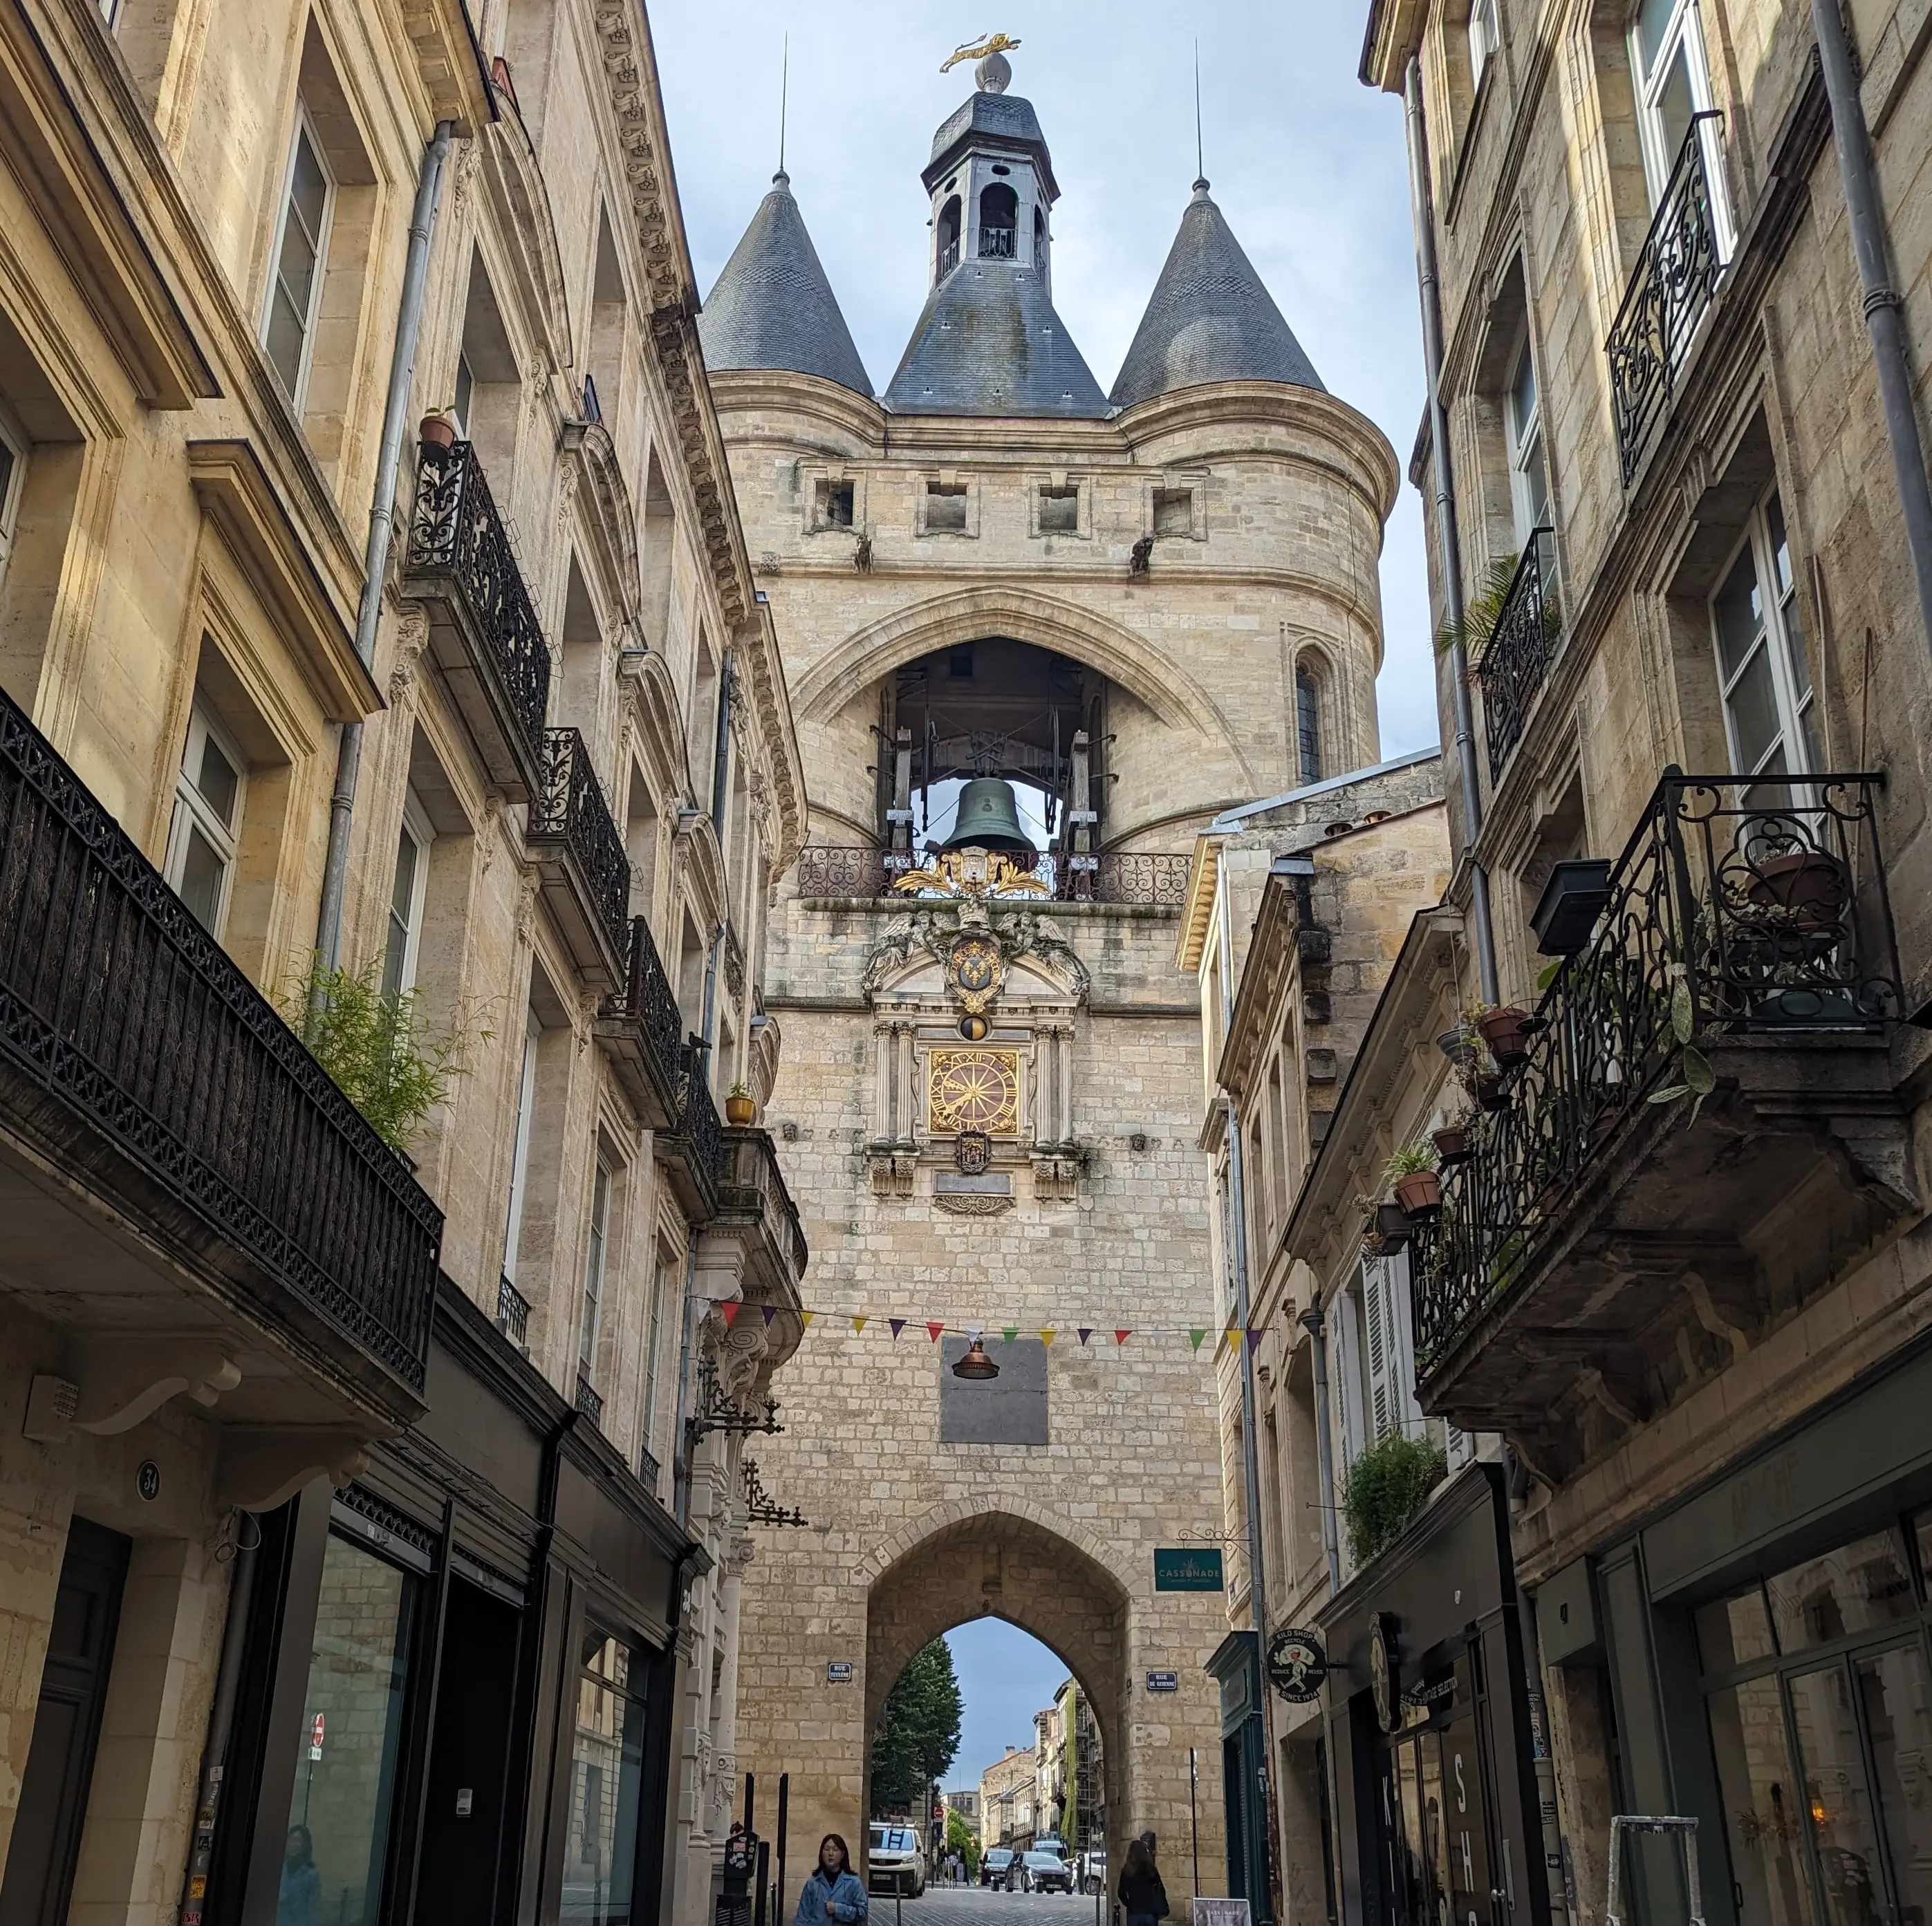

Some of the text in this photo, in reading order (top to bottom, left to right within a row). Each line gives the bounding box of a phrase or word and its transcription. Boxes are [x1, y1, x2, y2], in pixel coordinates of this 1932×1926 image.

[965, 1053, 982, 1063] XII
[1007, 1089, 1017, 1098] III
[144, 1468, 157, 1494] 34
[1276, 1630, 1314, 1640] KILO SHOP
[1438, 1675, 1458, 1697] SELECTION
[1281, 1691, 1318, 1701] SINCE 1974
